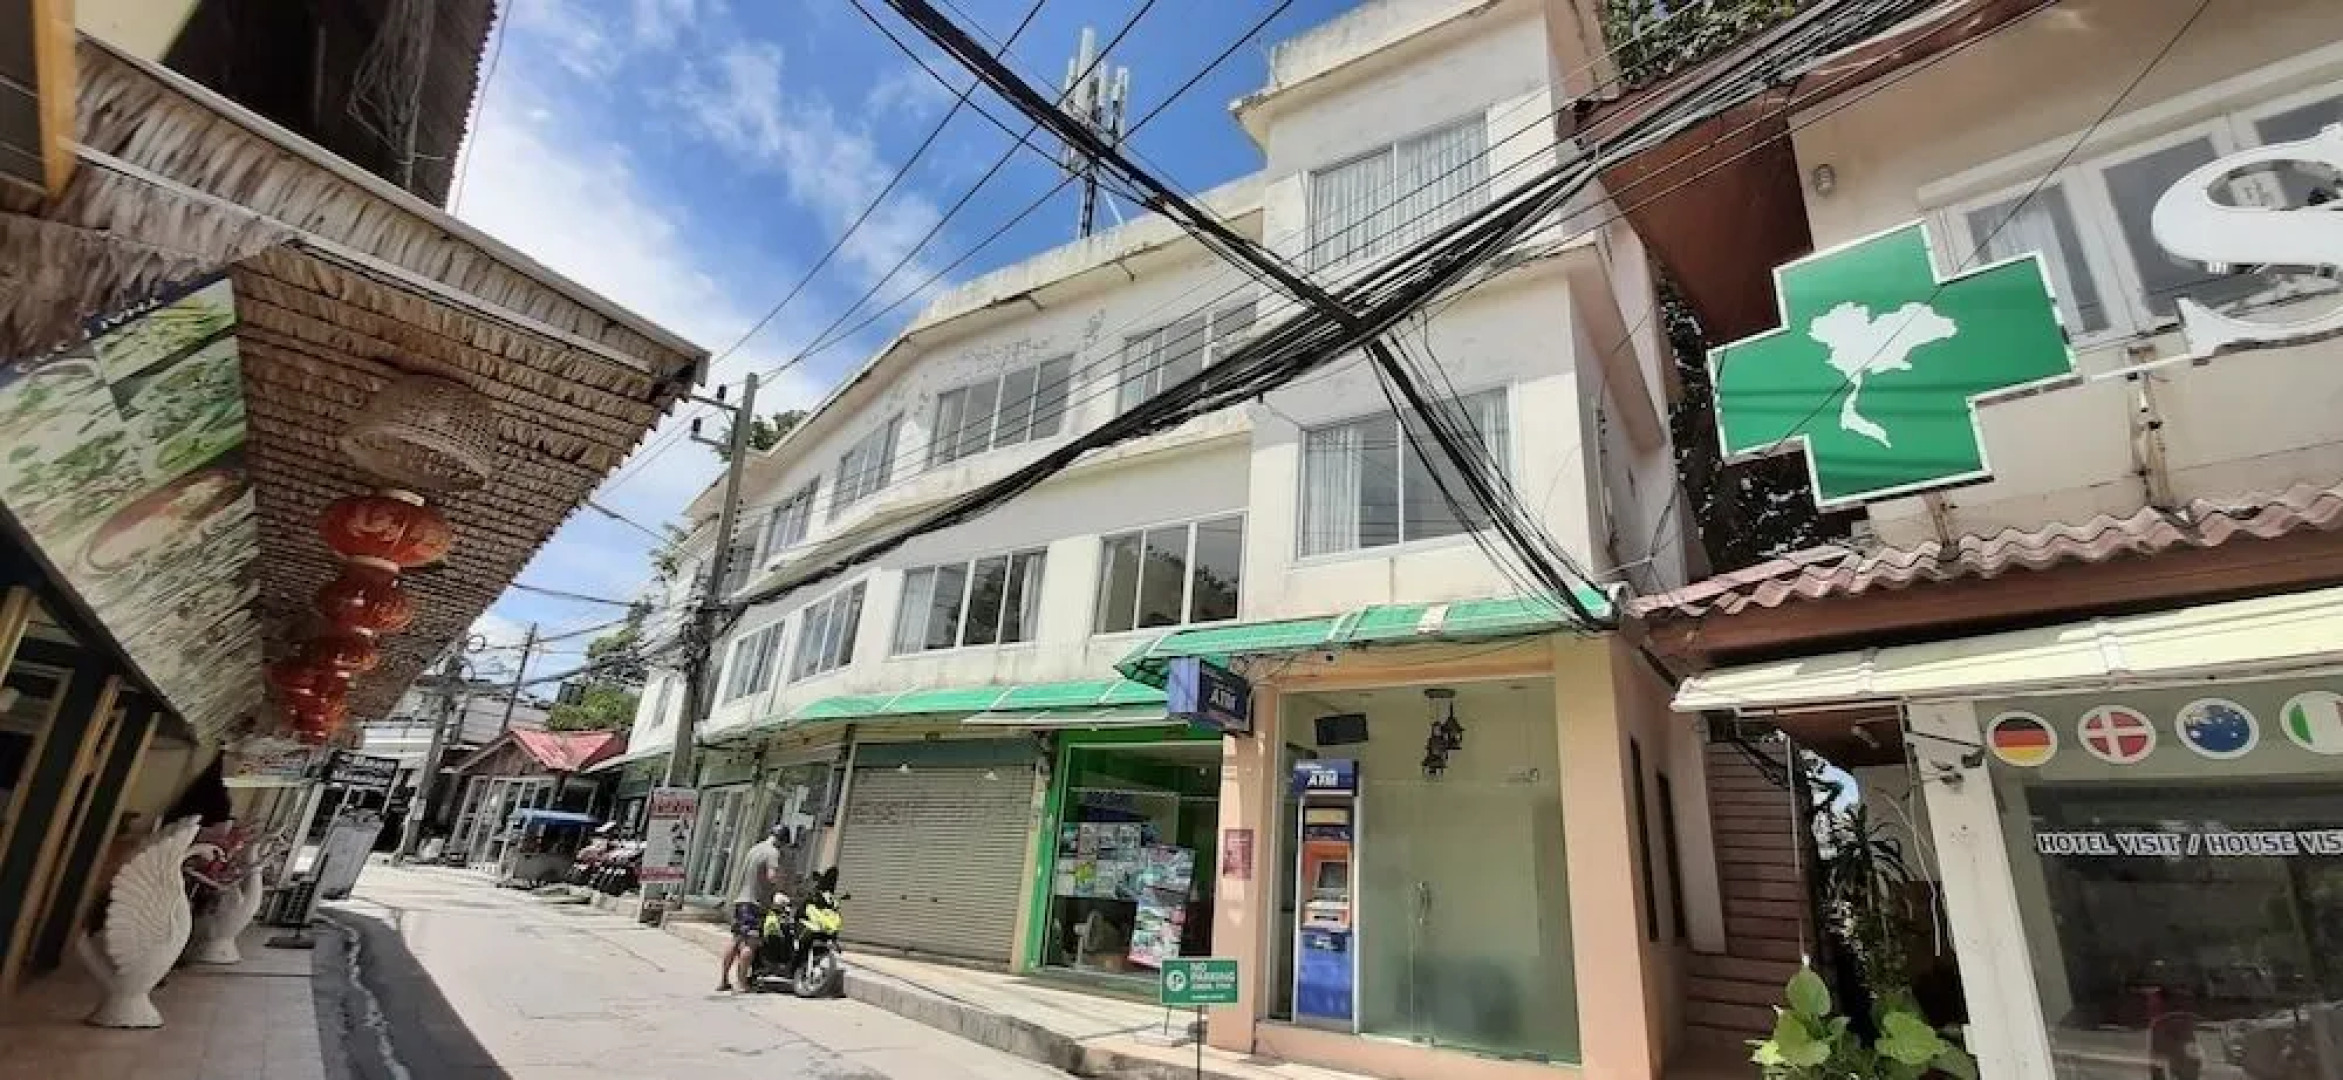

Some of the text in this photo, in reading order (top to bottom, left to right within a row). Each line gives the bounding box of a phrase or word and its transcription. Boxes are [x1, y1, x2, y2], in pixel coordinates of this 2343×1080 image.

[1208, 687, 1236, 711] ATM
[1307, 772, 1339, 786] ATM
[2036, 833, 2118, 855] HOTEL
[2115, 833, 2181, 855] VISIT
[2187, 833, 2200, 855] /
[2205, 832, 2299, 855] HOUSE
[1190, 962, 1207, 972] NO
[1190, 972, 1236, 983] PARKING
